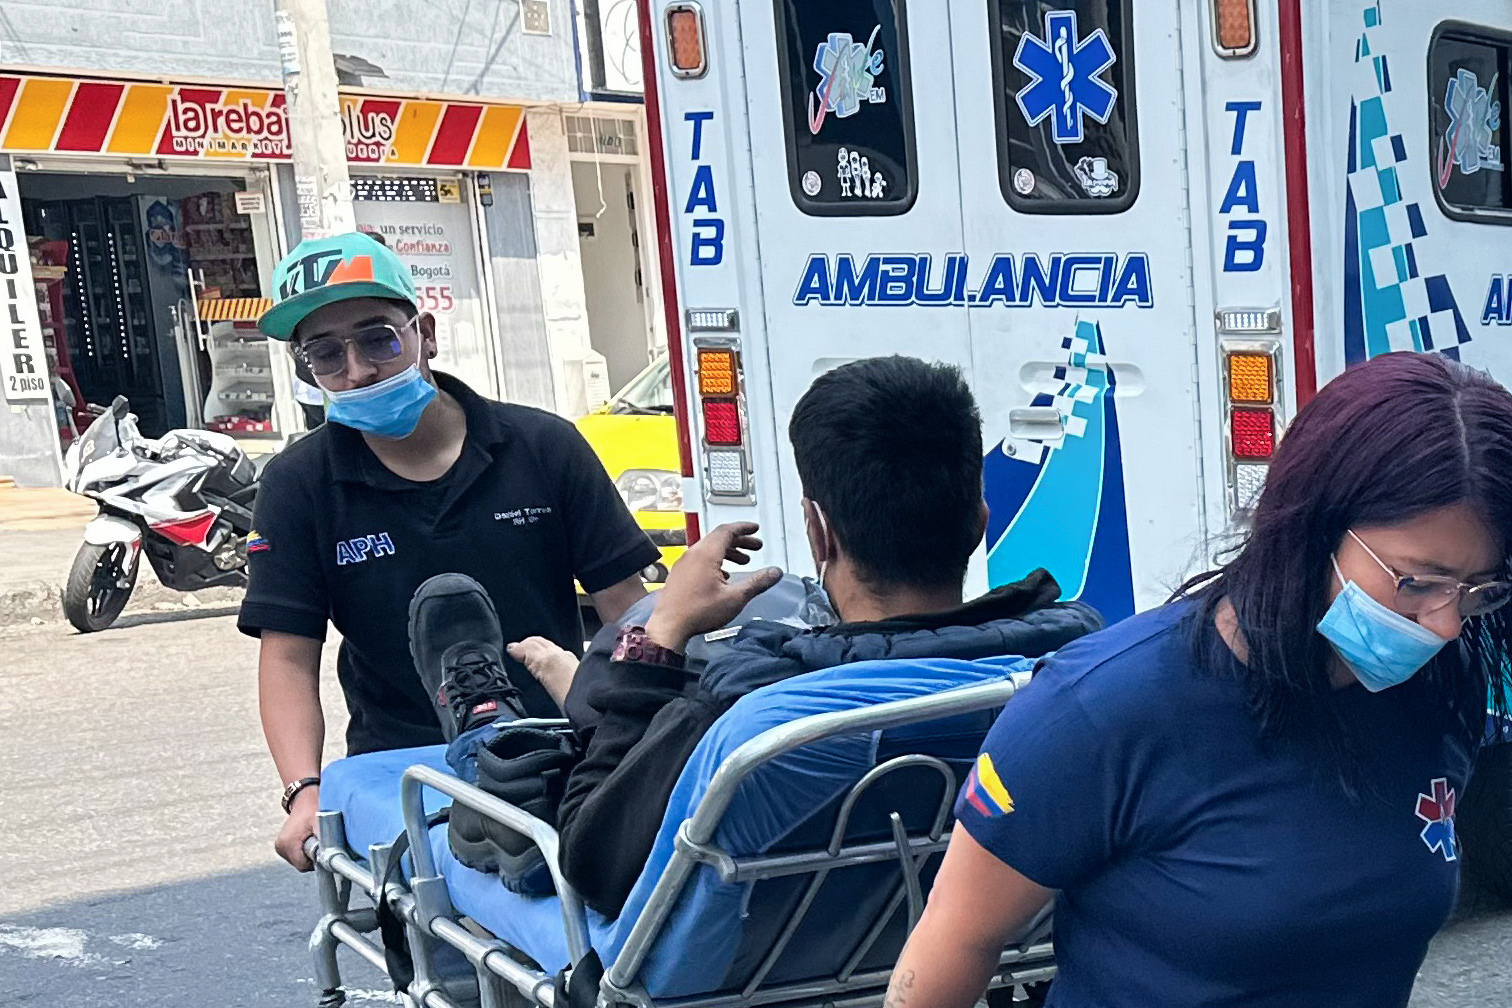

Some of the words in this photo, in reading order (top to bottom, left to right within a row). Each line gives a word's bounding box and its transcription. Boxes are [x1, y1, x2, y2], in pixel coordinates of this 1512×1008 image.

[340, 103, 393, 142] lus
[173, 138, 285, 154] MINIMARKET
[683, 111, 725, 267] TAB
[1218, 101, 1267, 273] TAB
[380, 225, 396, 235] un
[398, 223, 444, 237] servicio
[395, 239, 450, 254] Confianza
[410, 264, 451, 279] Bogotá
[792, 252, 1154, 308] AMBULANCIA
[9, 376, 17, 392] 2
[20, 376, 45, 392] piso
[336, 532, 396, 566] APH
